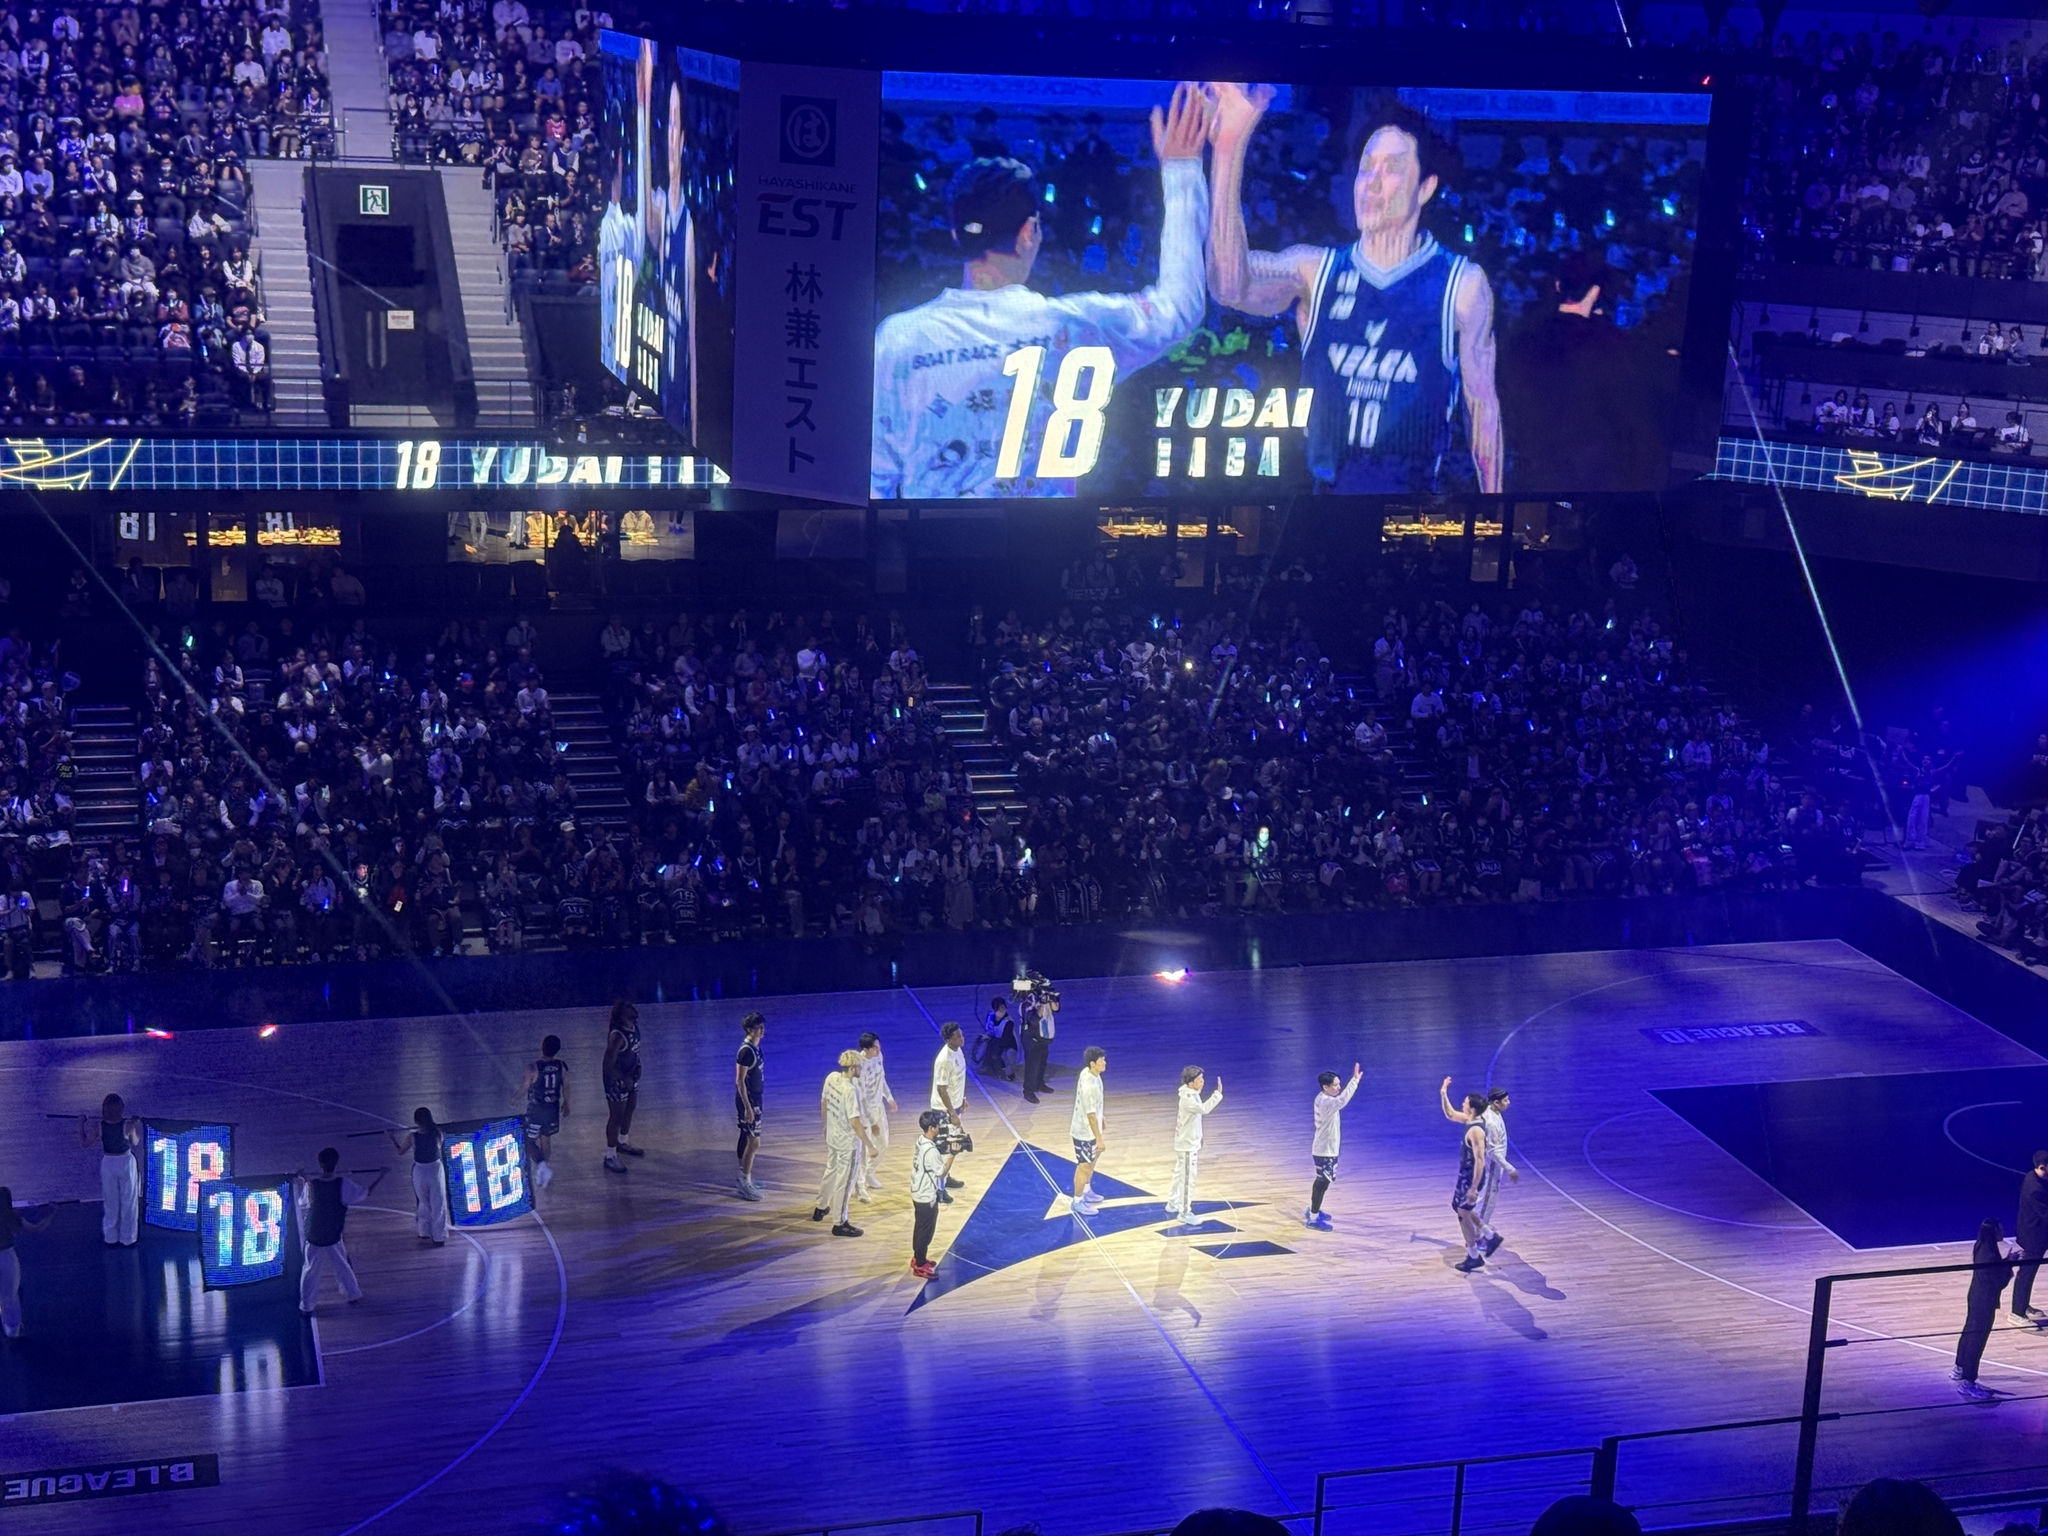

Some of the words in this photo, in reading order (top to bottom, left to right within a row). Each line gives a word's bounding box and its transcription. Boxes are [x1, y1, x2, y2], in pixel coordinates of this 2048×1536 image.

[758, 174, 857, 194] HAYASHIKANE
[757, 192, 857, 241] EST
[784, 261, 823, 474] 林兼エスト
[995, 345, 1117, 478] 18
[1155, 387, 1314, 428] YUDAI
[396, 440, 441, 489] 18
[471, 446, 623, 484] YUDAI
[544, 1073, 556, 1089] 11
[451, 1132, 523, 1213] 18
[209, 1190, 283, 1267] 18
[4, 1462, 195, 1499] B.LEAGUE
